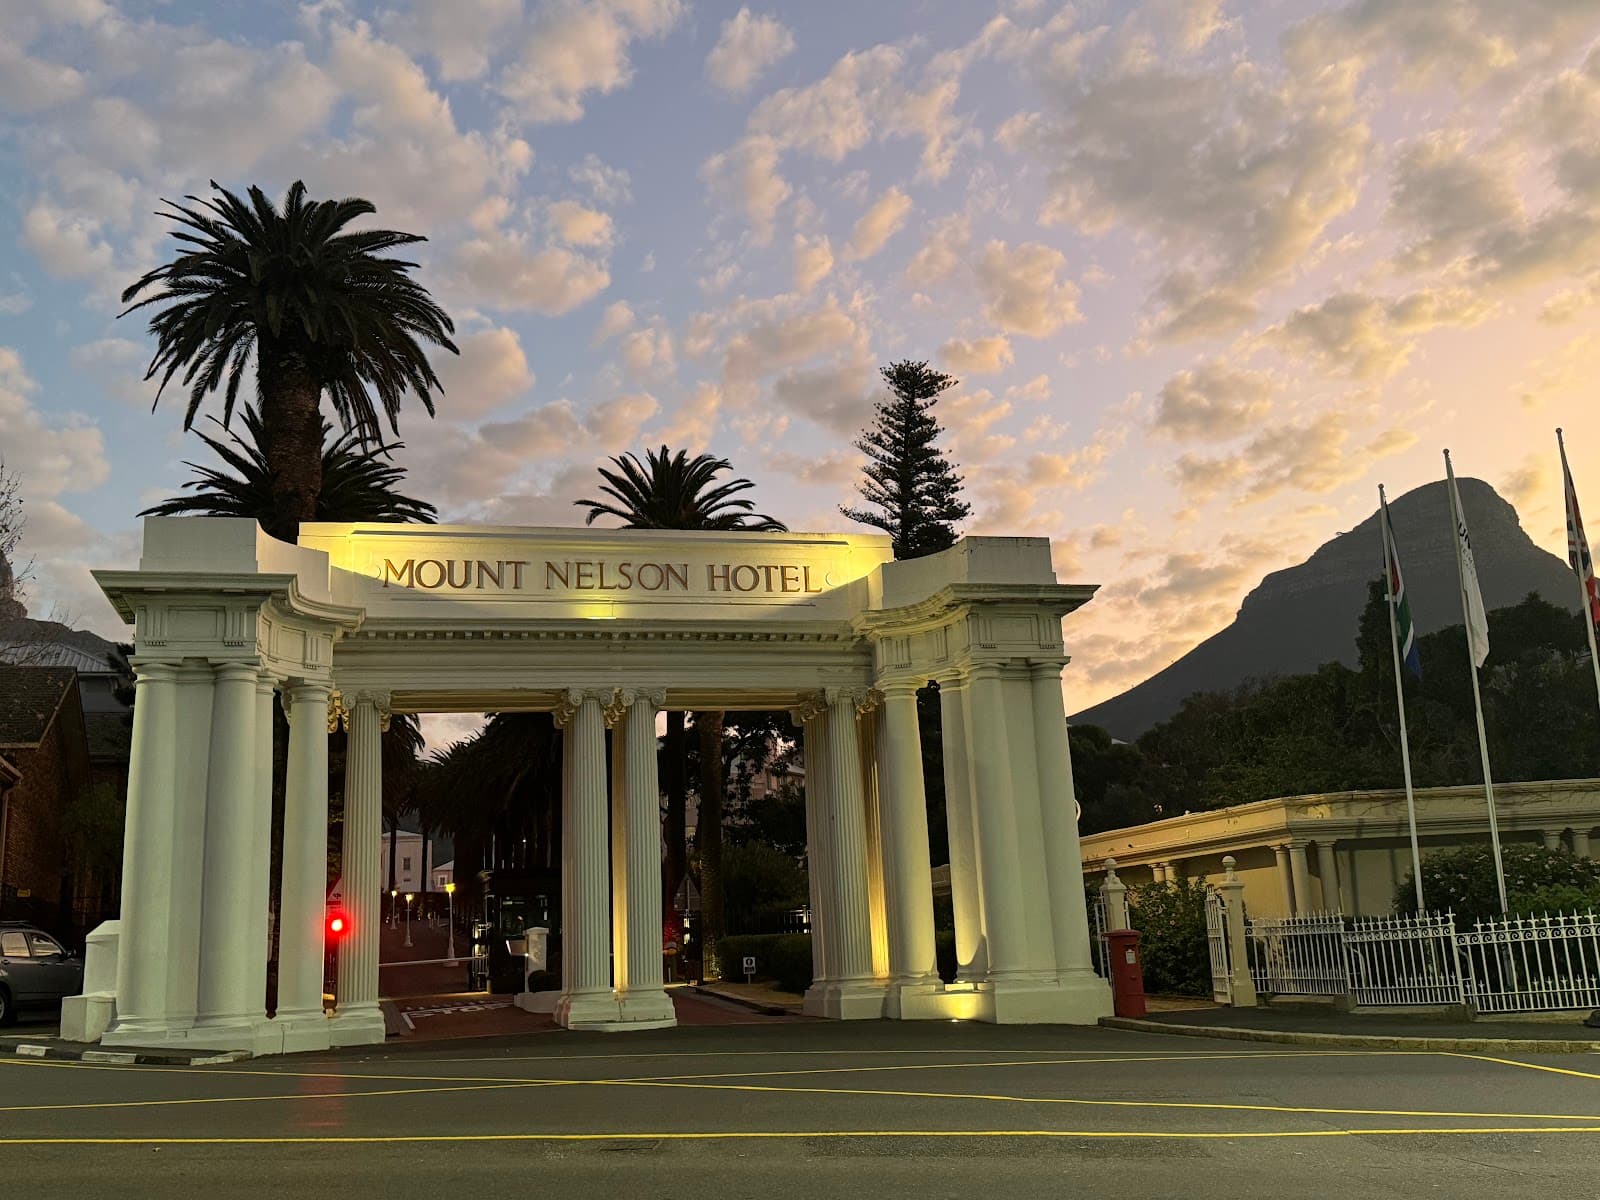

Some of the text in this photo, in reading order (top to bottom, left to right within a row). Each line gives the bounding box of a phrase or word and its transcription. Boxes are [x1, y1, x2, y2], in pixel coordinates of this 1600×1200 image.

[382, 558, 822, 592] MOUNT NELSON HOTEL
